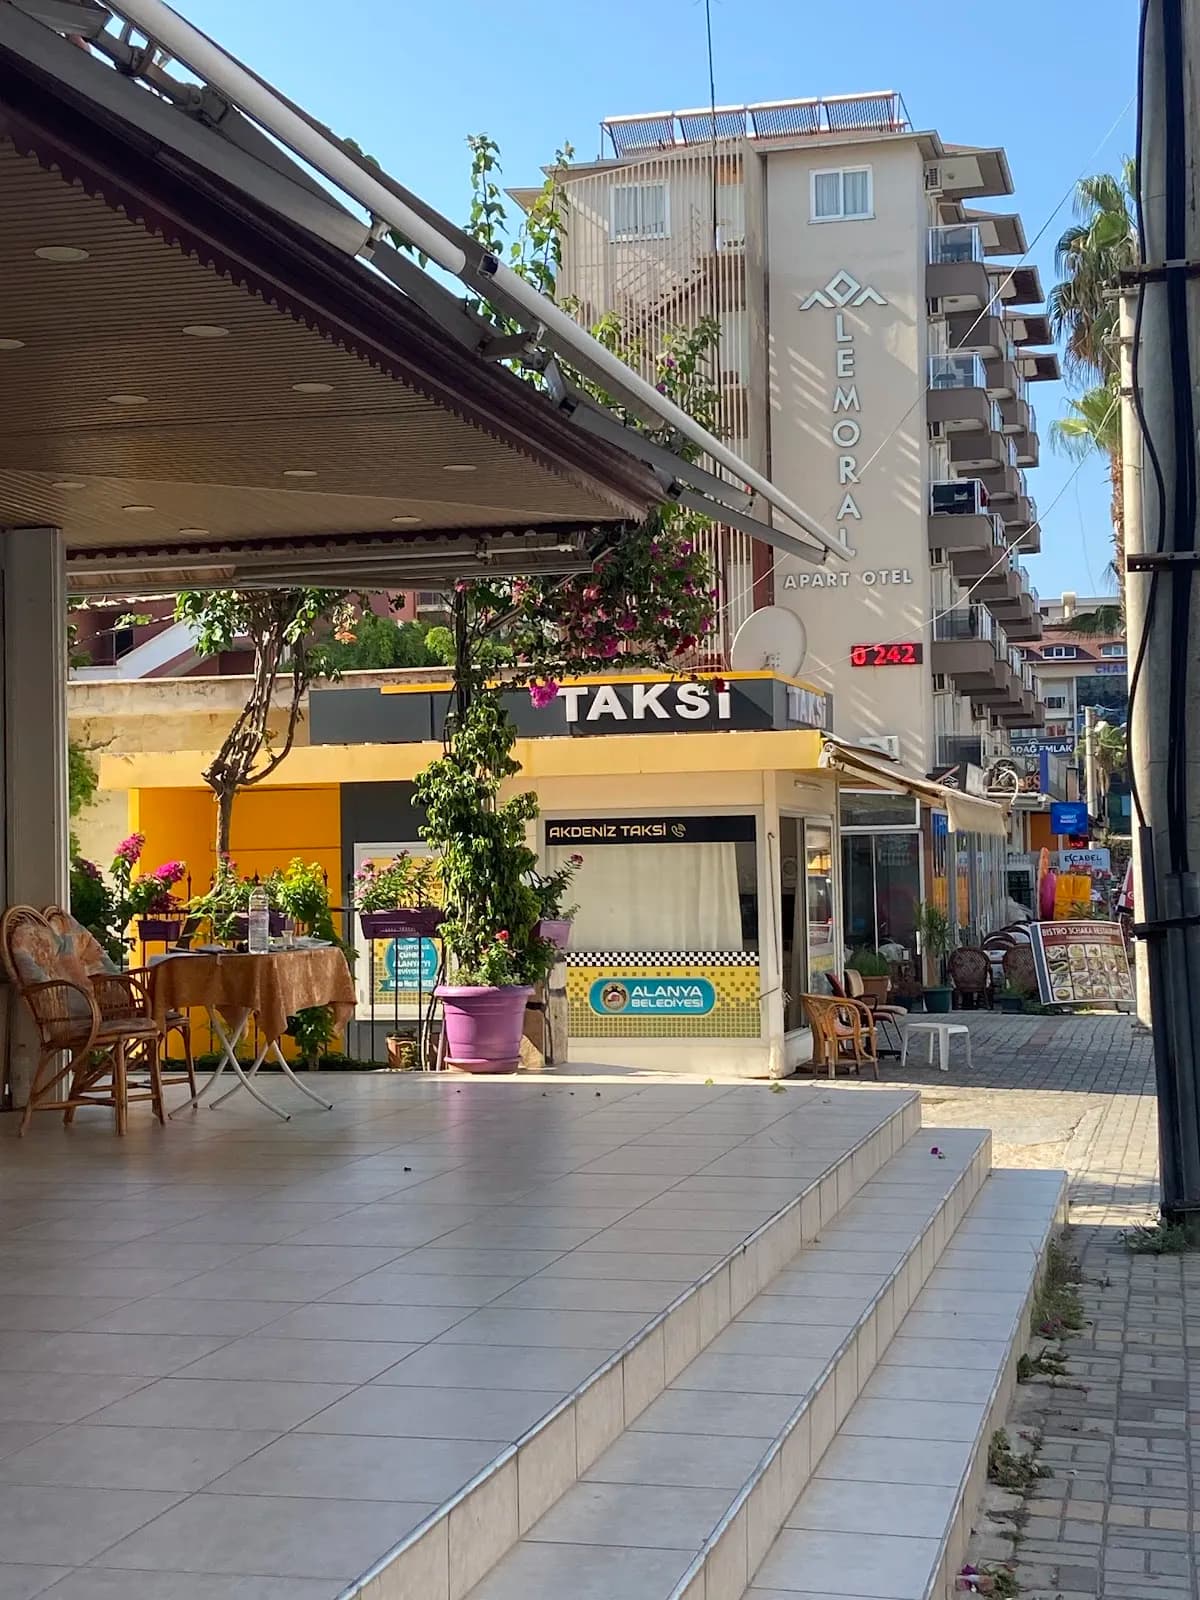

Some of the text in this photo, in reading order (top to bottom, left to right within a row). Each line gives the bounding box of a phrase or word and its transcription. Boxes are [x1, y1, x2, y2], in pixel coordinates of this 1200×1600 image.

[784, 570, 912, 589] APART OTEL
[874, 645, 915, 664] 242
[549, 823, 666, 838] AKDENİZ TAKSİ
[1042, 927, 1068, 937] BISTRO
[631, 986, 703, 997] ALANYA
[631, 997, 703, 1008] BELEDİYESİ
